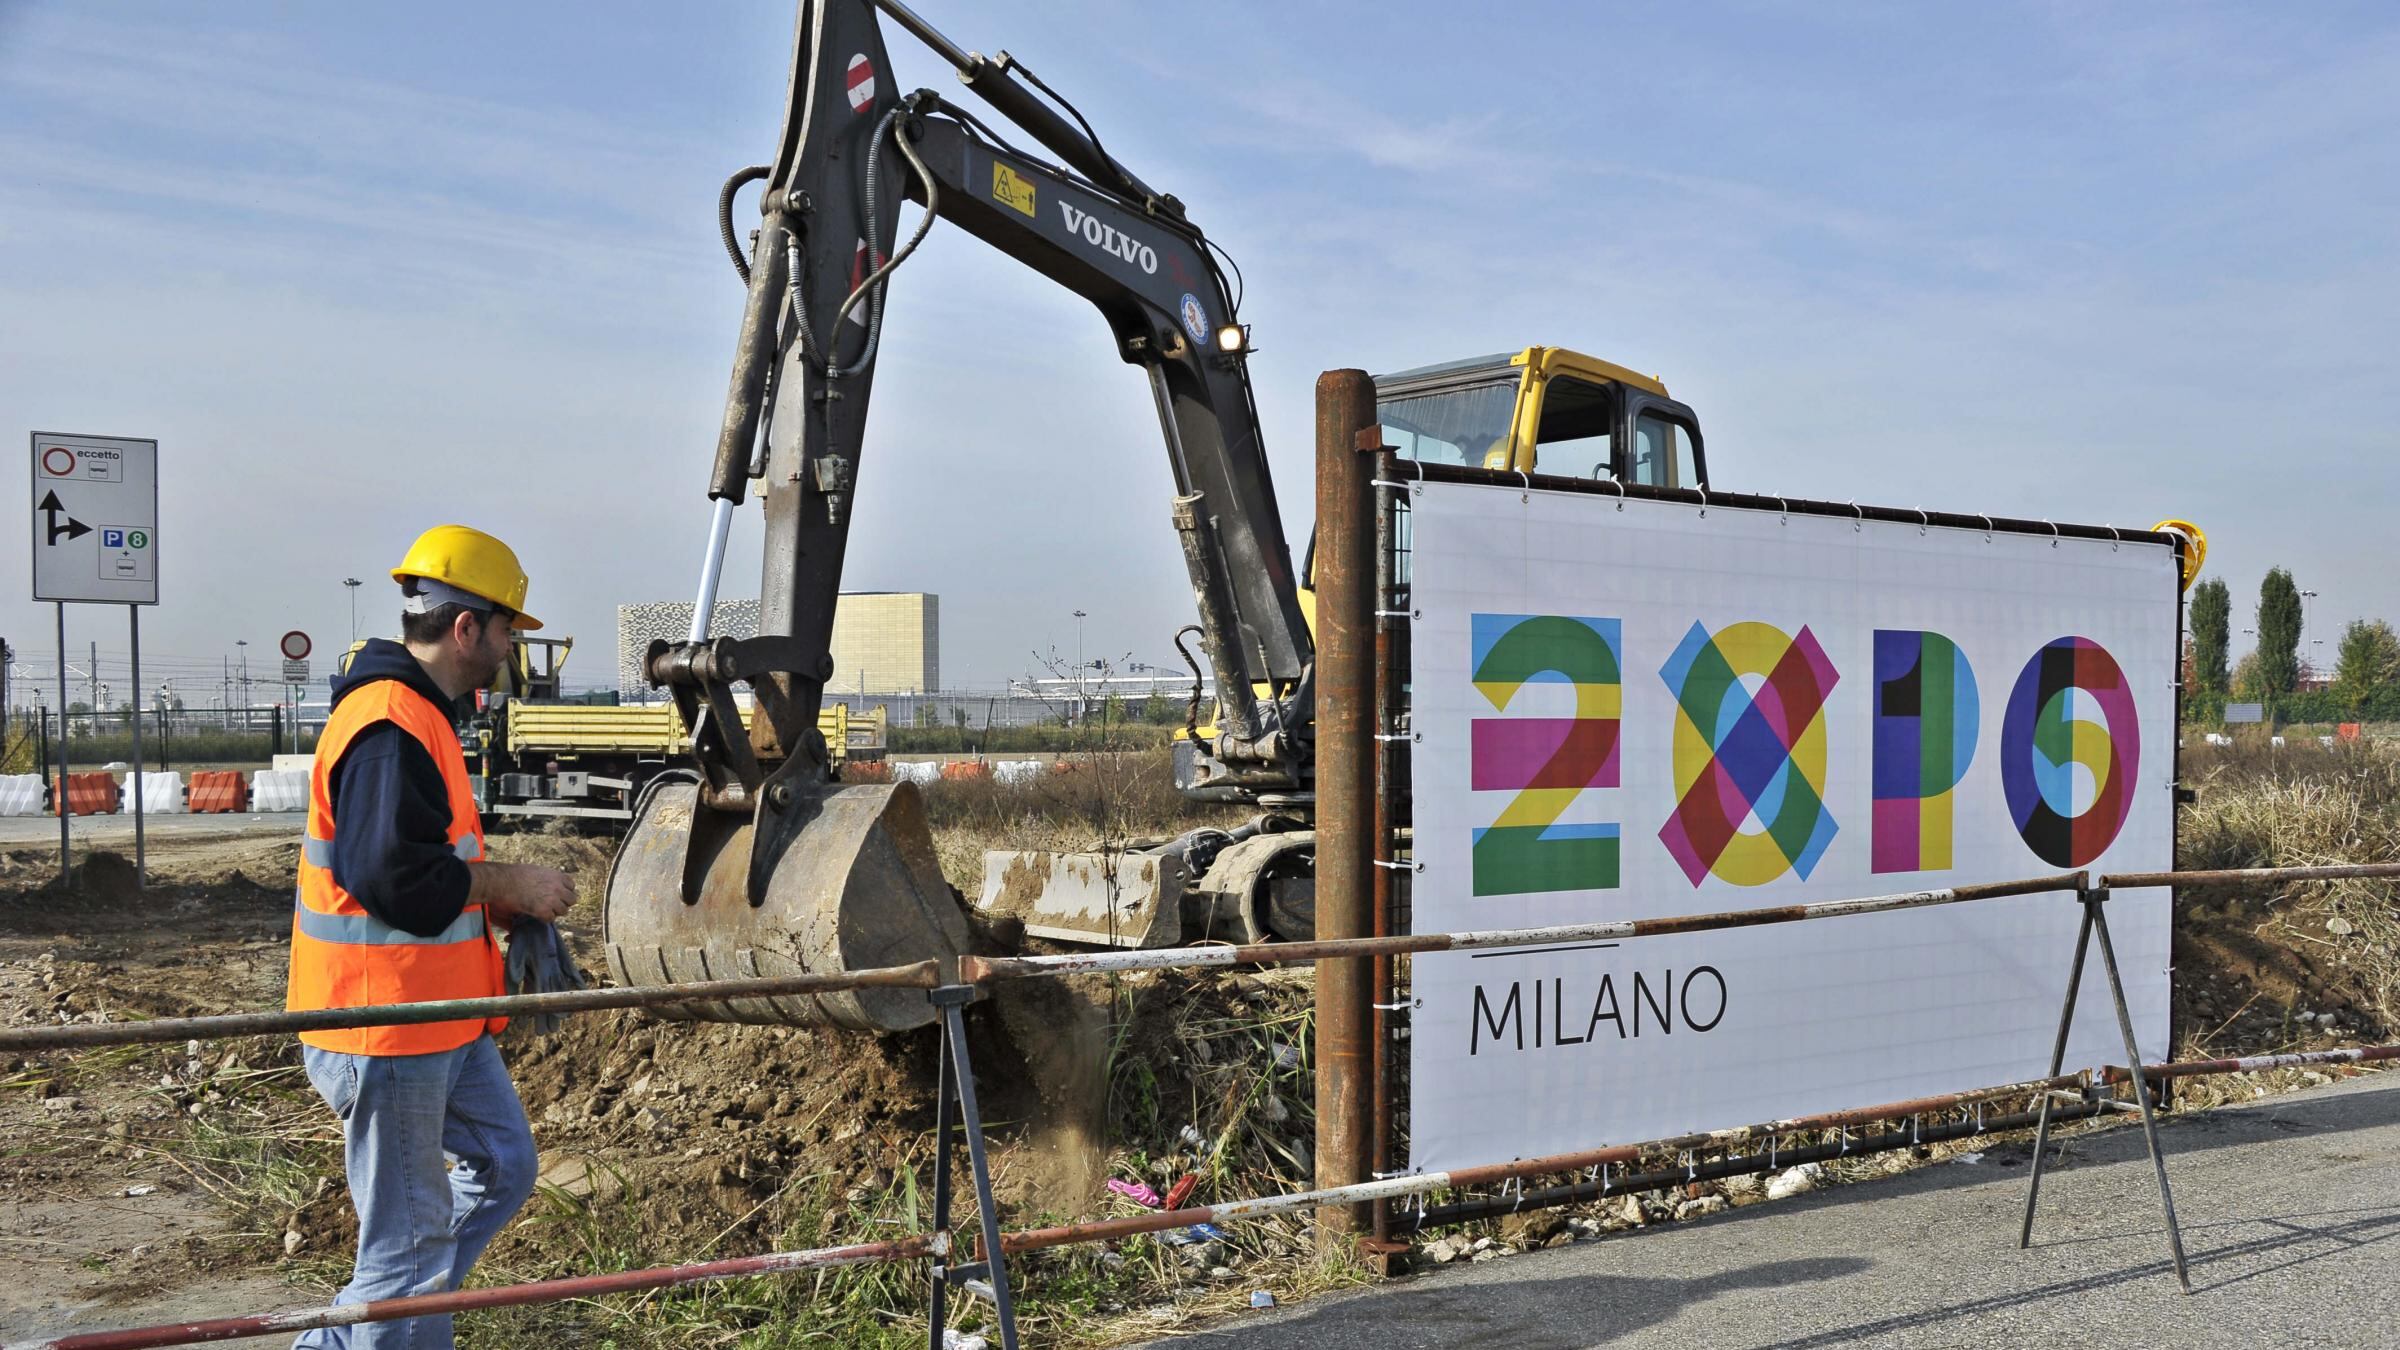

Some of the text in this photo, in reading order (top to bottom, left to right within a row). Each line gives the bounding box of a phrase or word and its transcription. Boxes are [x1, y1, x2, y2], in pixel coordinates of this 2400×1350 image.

[1058, 200, 1158, 274] VOLVO
[77, 450, 120, 460] eccetto
[1470, 965, 1728, 1056] MILANO
